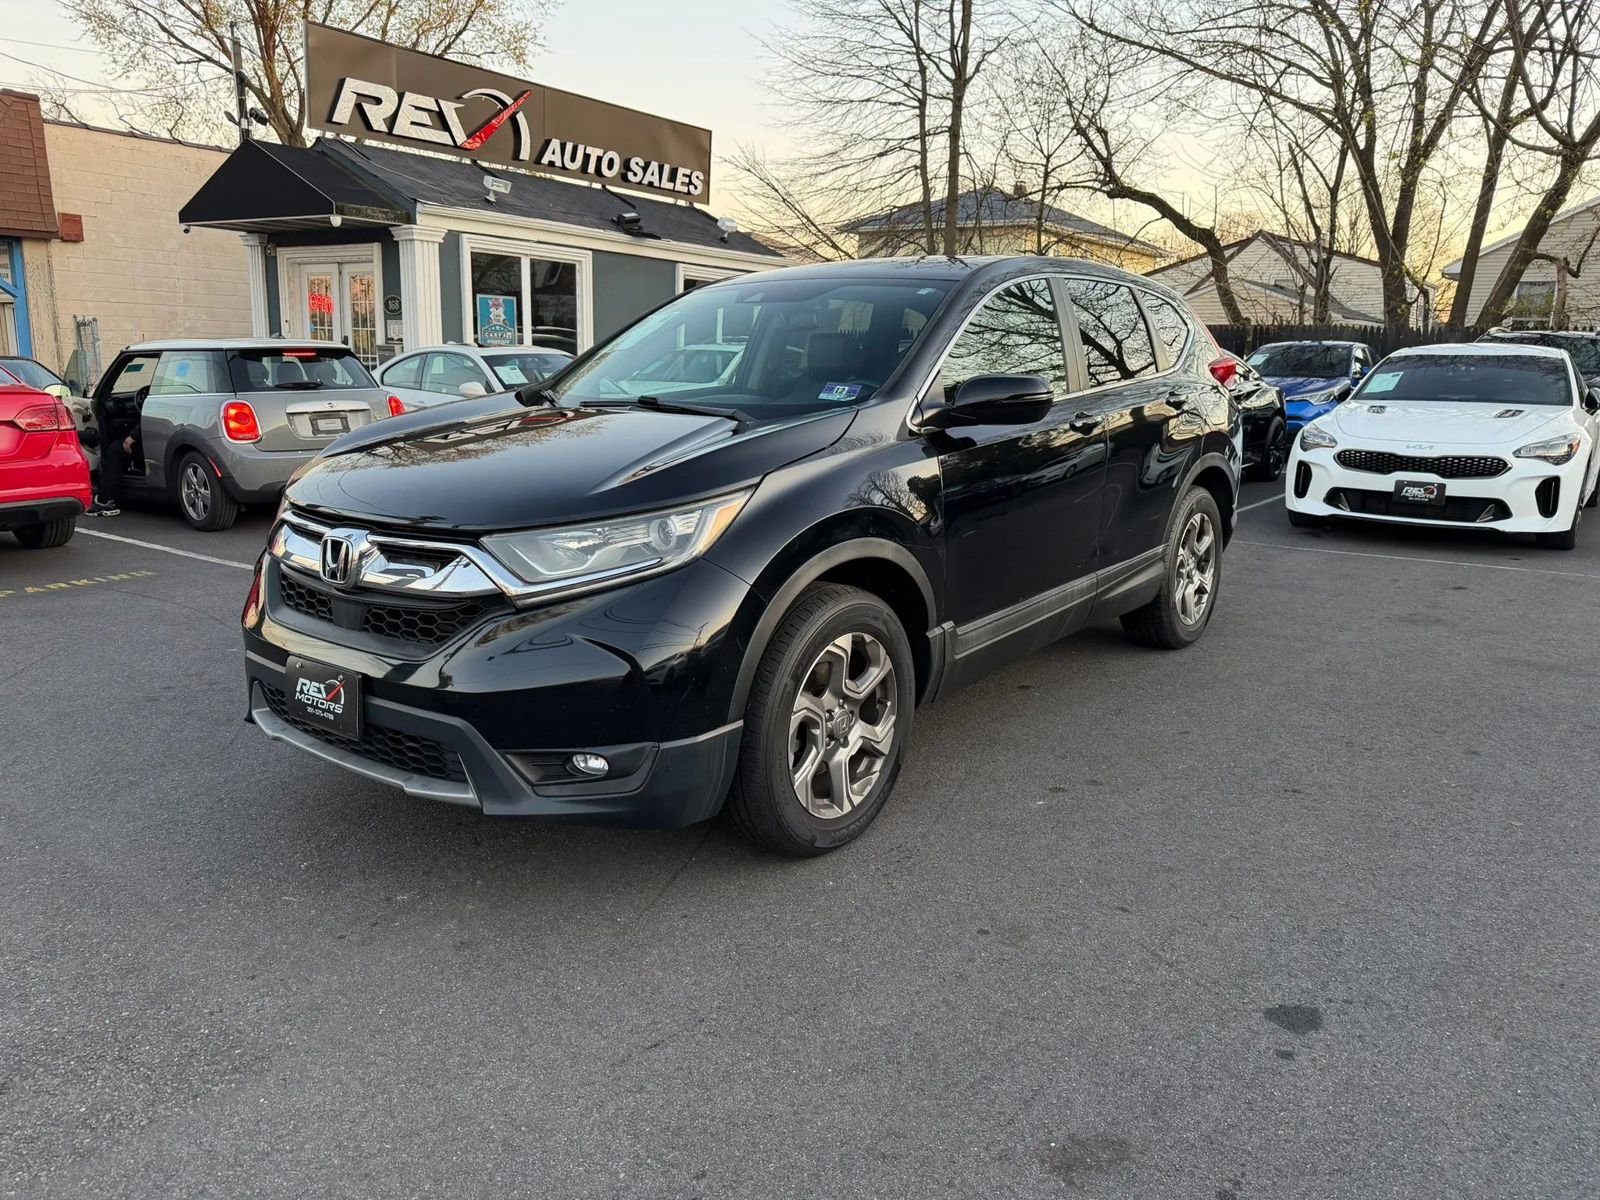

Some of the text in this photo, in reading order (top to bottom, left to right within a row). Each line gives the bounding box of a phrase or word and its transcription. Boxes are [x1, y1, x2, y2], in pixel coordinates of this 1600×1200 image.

[331, 77, 534, 150] REV
[540, 138, 704, 196] AUTO SALES
[310, 293, 334, 313] OPEN
[296, 677, 345, 702] REV
[295, 692, 344, 714] MOTORS
